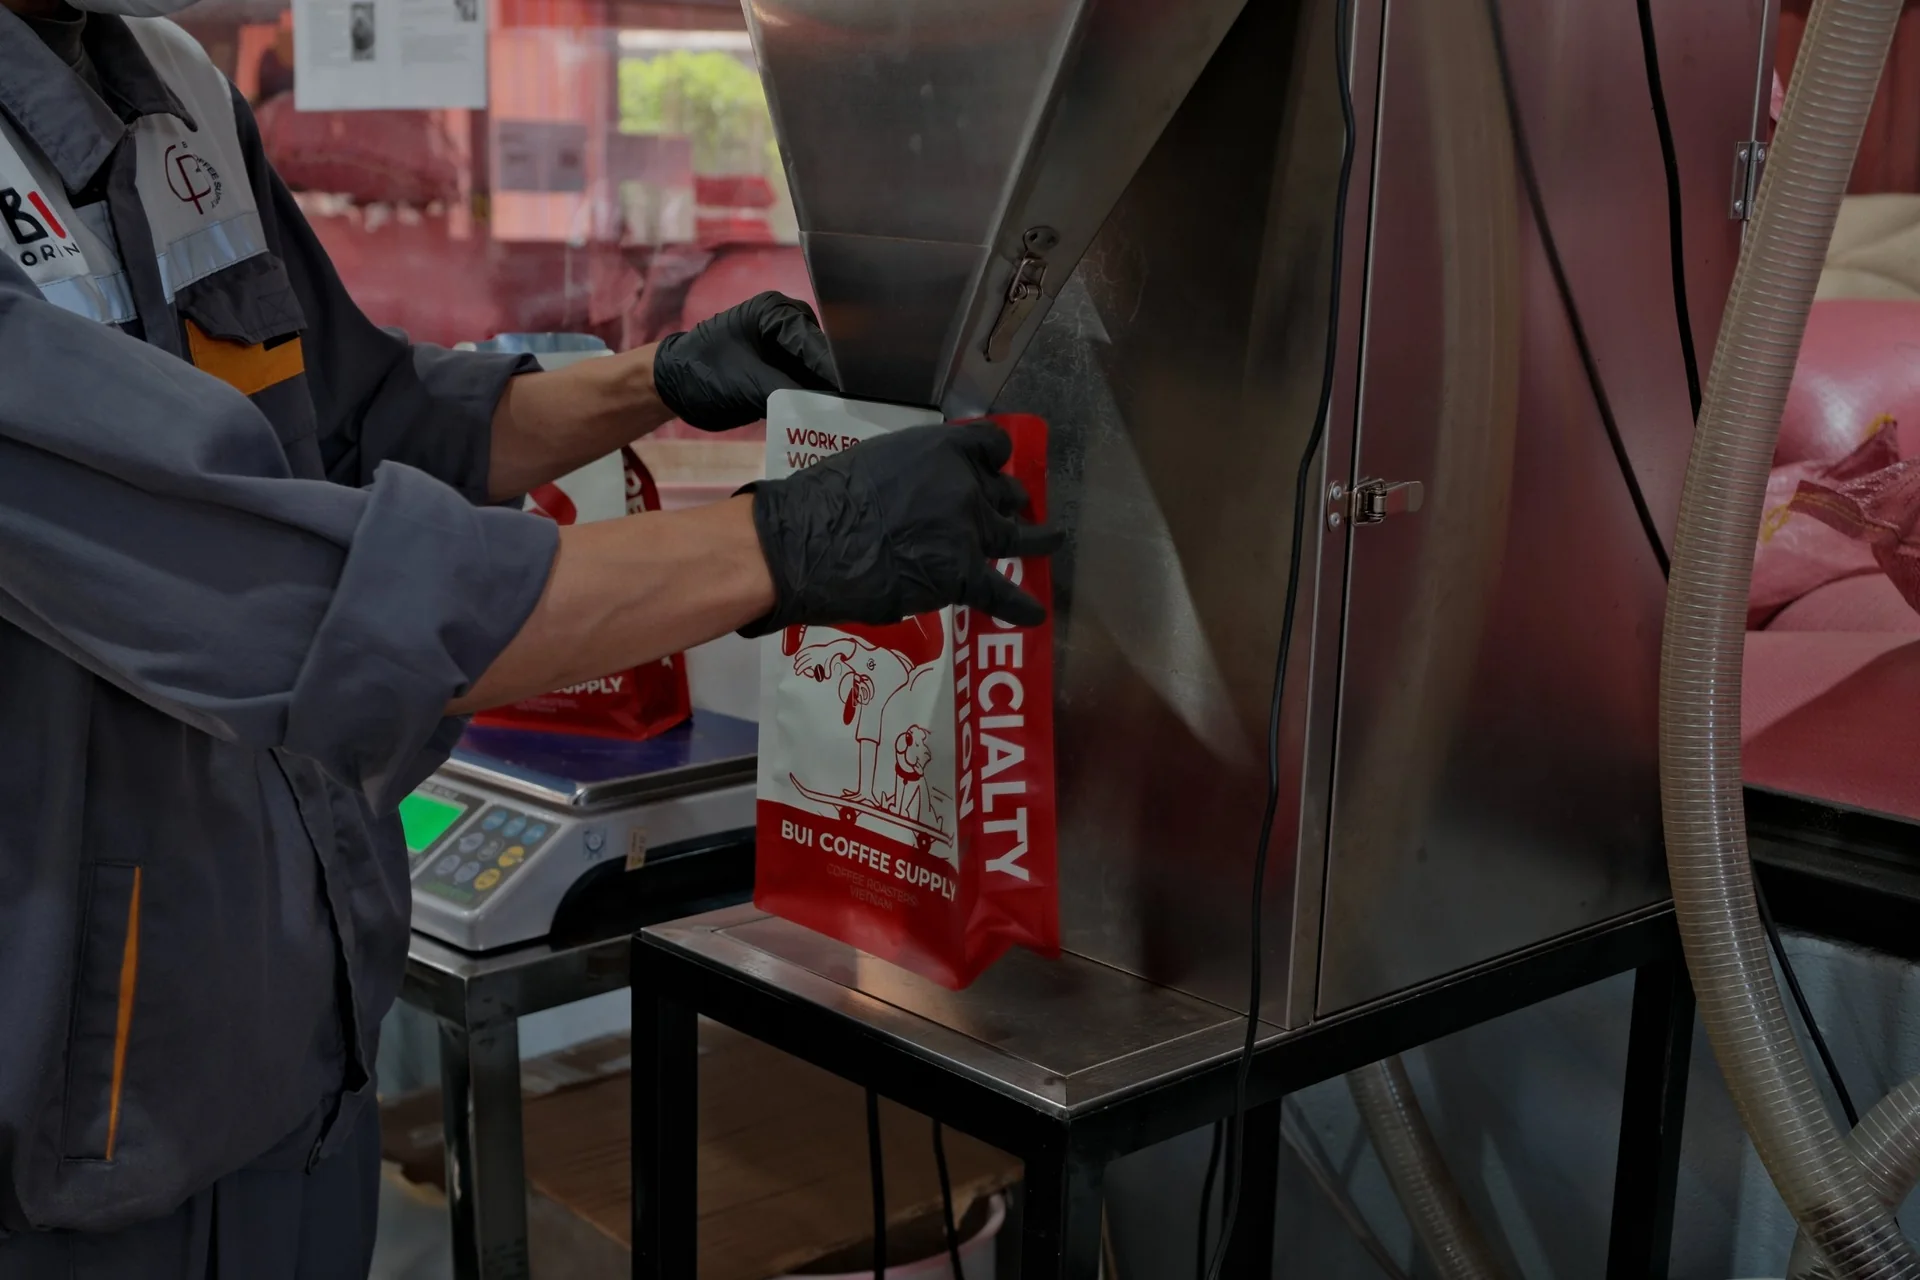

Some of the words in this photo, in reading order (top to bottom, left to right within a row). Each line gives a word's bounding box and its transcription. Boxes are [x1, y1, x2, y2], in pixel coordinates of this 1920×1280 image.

[786, 427, 839, 451] WORK
[553, 676, 624, 694] PPLY
[953, 604, 974, 820] DITION
[978, 557, 1030, 882] SECIALTY
[781, 819, 813, 847] BUI
[819, 832, 891, 874] COFFEE
[894, 858, 956, 902] SUPPLY
[826, 863, 865, 885] COFFEE
[850, 886, 893, 912] VIETNAM
